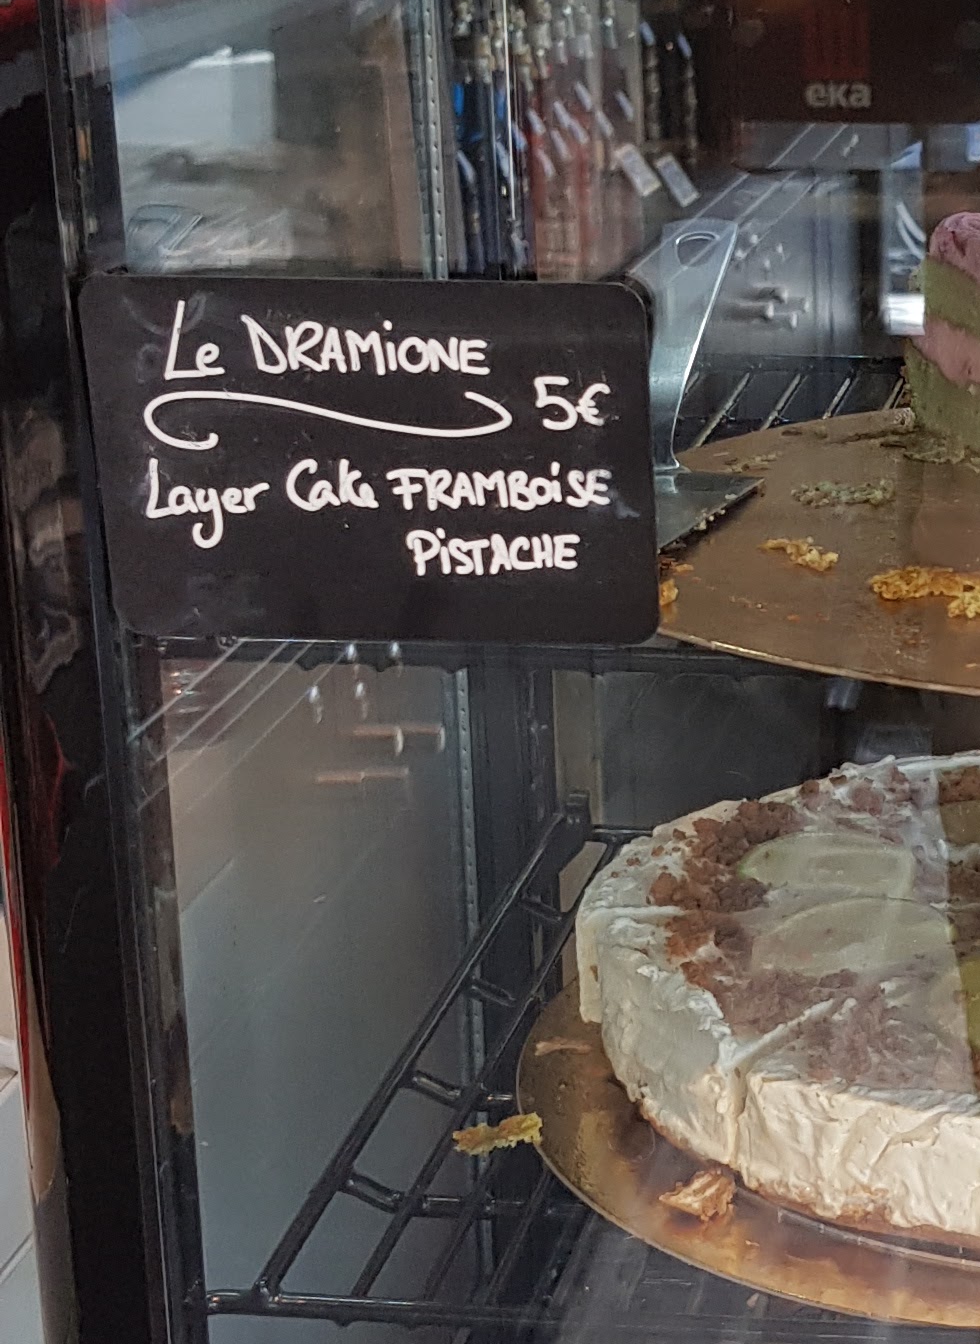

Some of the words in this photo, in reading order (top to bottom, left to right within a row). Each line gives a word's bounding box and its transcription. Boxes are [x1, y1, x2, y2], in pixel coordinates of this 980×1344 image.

[164, 300, 225, 380] Le
[534, 376, 610, 430] 5€
[146, 458, 269, 548] Layer
[286, 459, 379, 511] Cake
